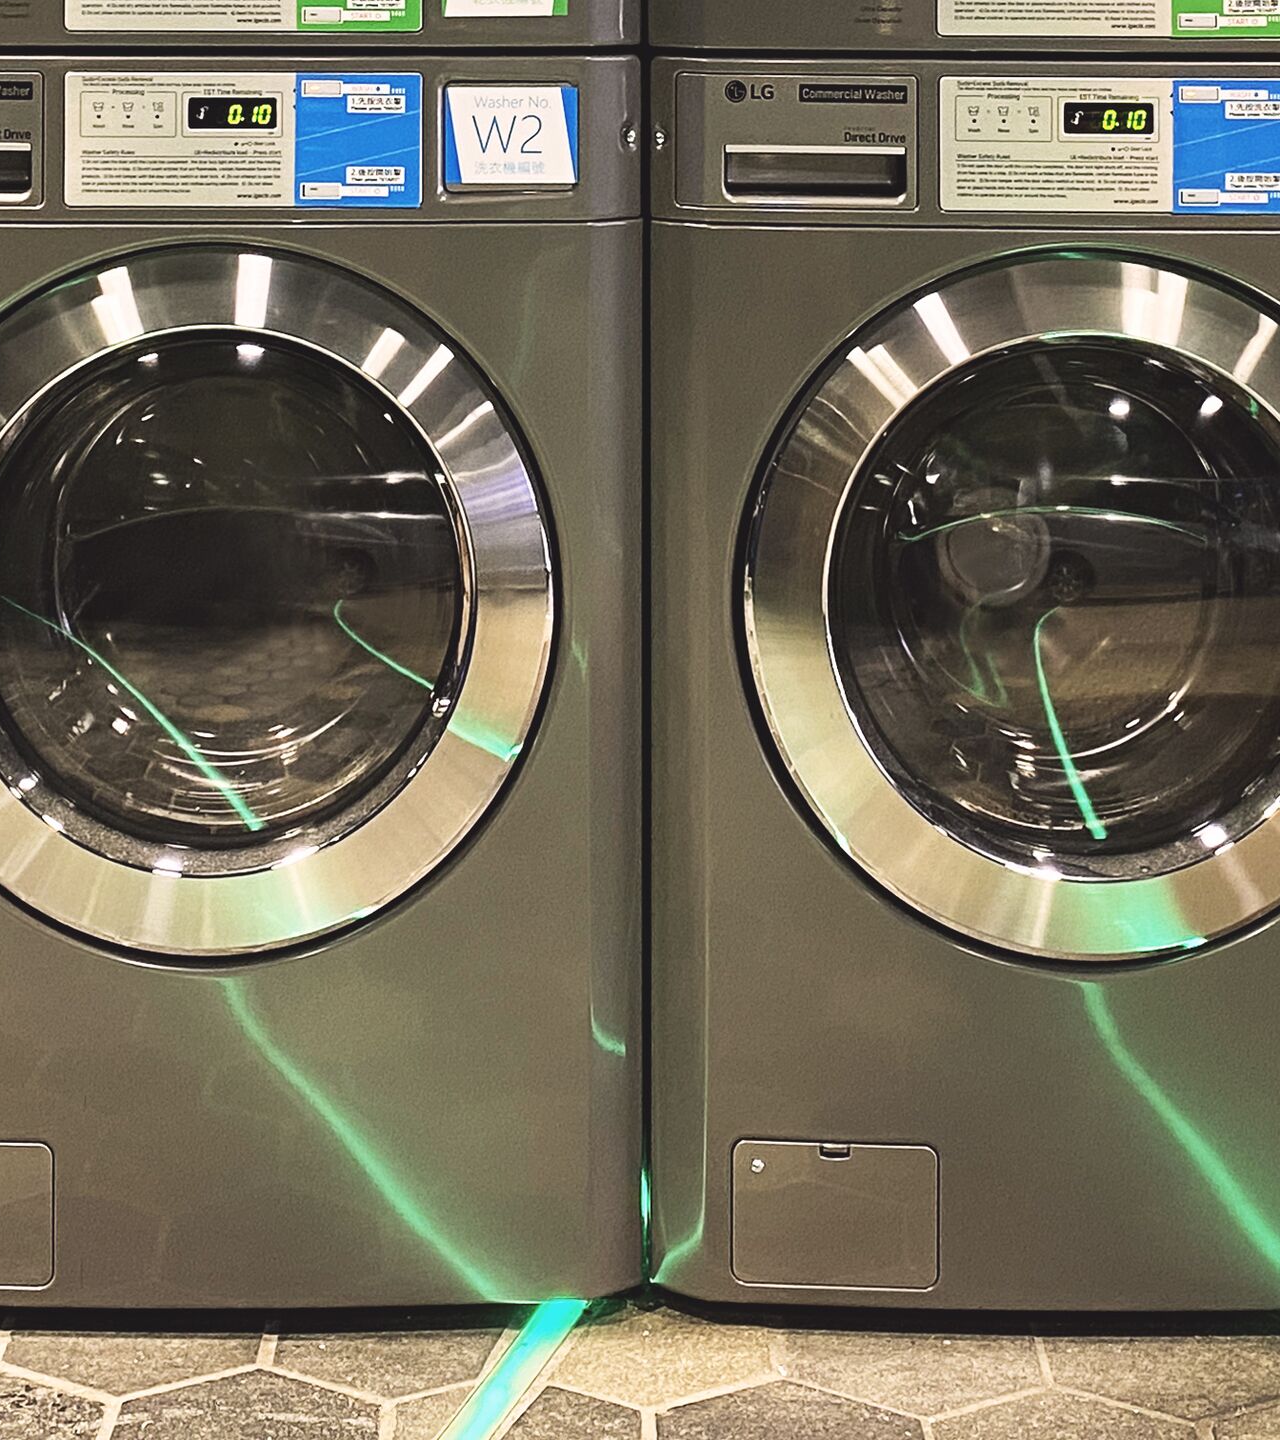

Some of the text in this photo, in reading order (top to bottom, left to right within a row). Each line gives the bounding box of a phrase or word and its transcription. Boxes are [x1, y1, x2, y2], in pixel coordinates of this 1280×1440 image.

[751, 85, 774, 99] LG
[802, 88, 905, 100] Commercial Washer
[474, 96, 551, 109] Washer No.
[227, 104, 272, 124] 0.10
[1102, 110, 1146, 130] 0.10
[4, 129, 31, 139] Drive
[472, 115, 542, 154] W2
[844, 132, 906, 143] Direct Drive
